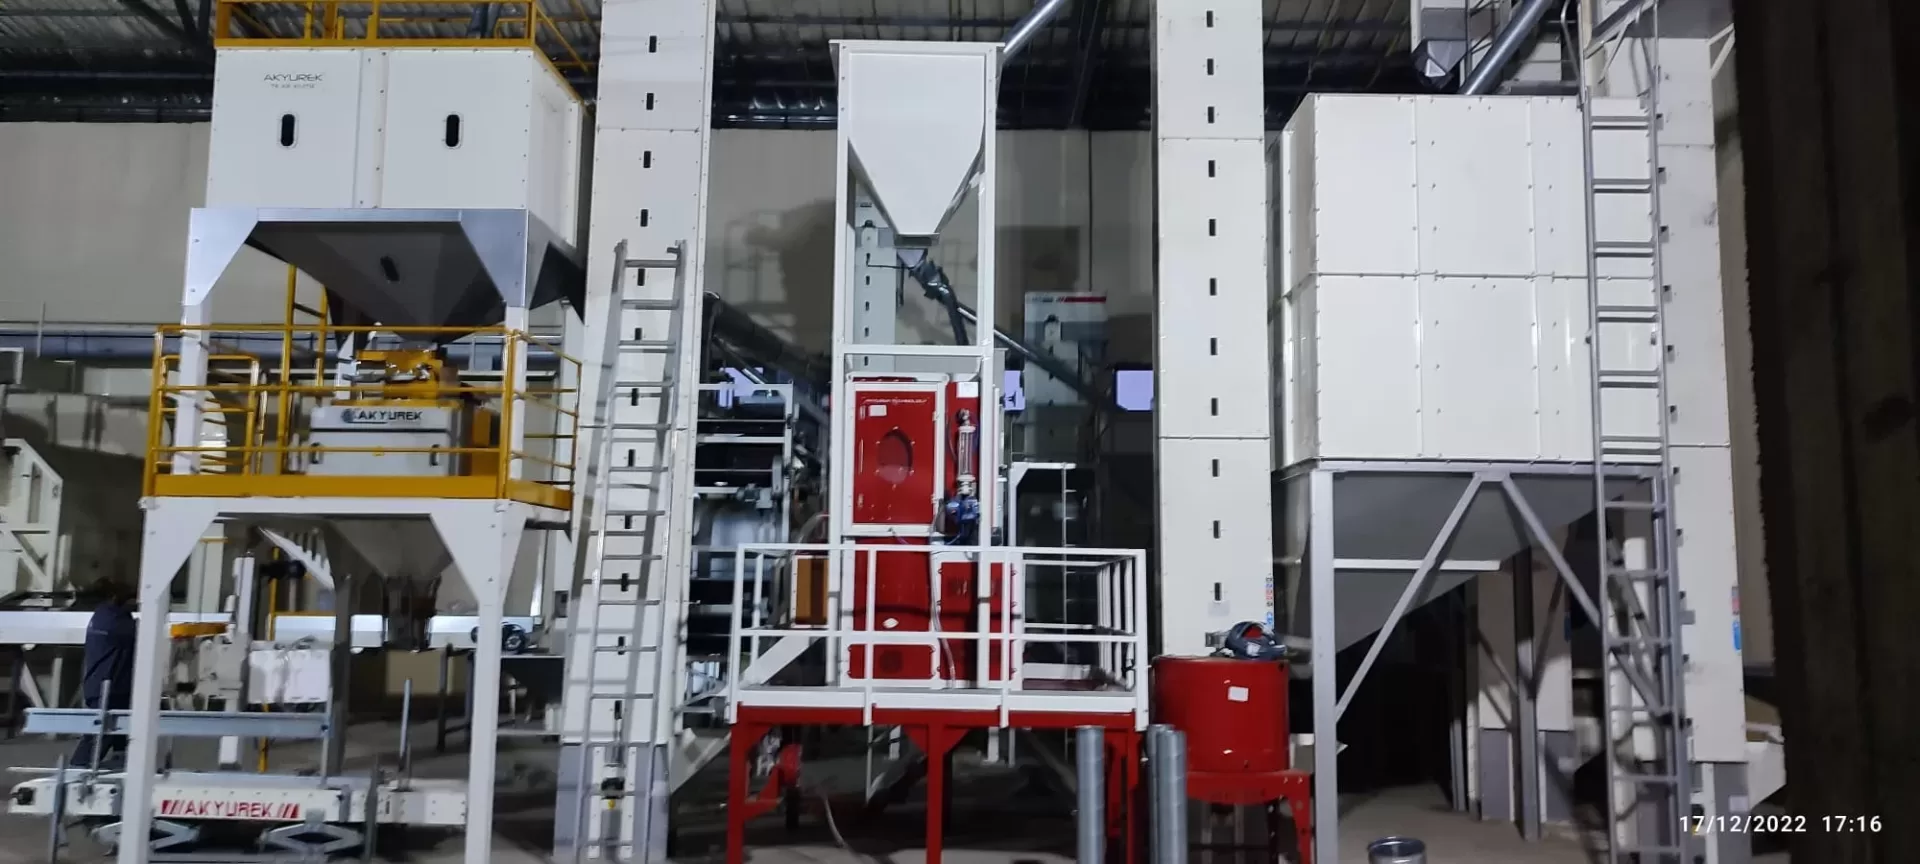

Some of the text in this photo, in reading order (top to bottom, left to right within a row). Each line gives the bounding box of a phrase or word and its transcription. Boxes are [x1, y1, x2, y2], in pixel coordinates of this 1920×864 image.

[263, 73, 323, 81] AKYUREK
[358, 410, 423, 420] AKYUREK
[184, 800, 274, 818] AKYUREK
